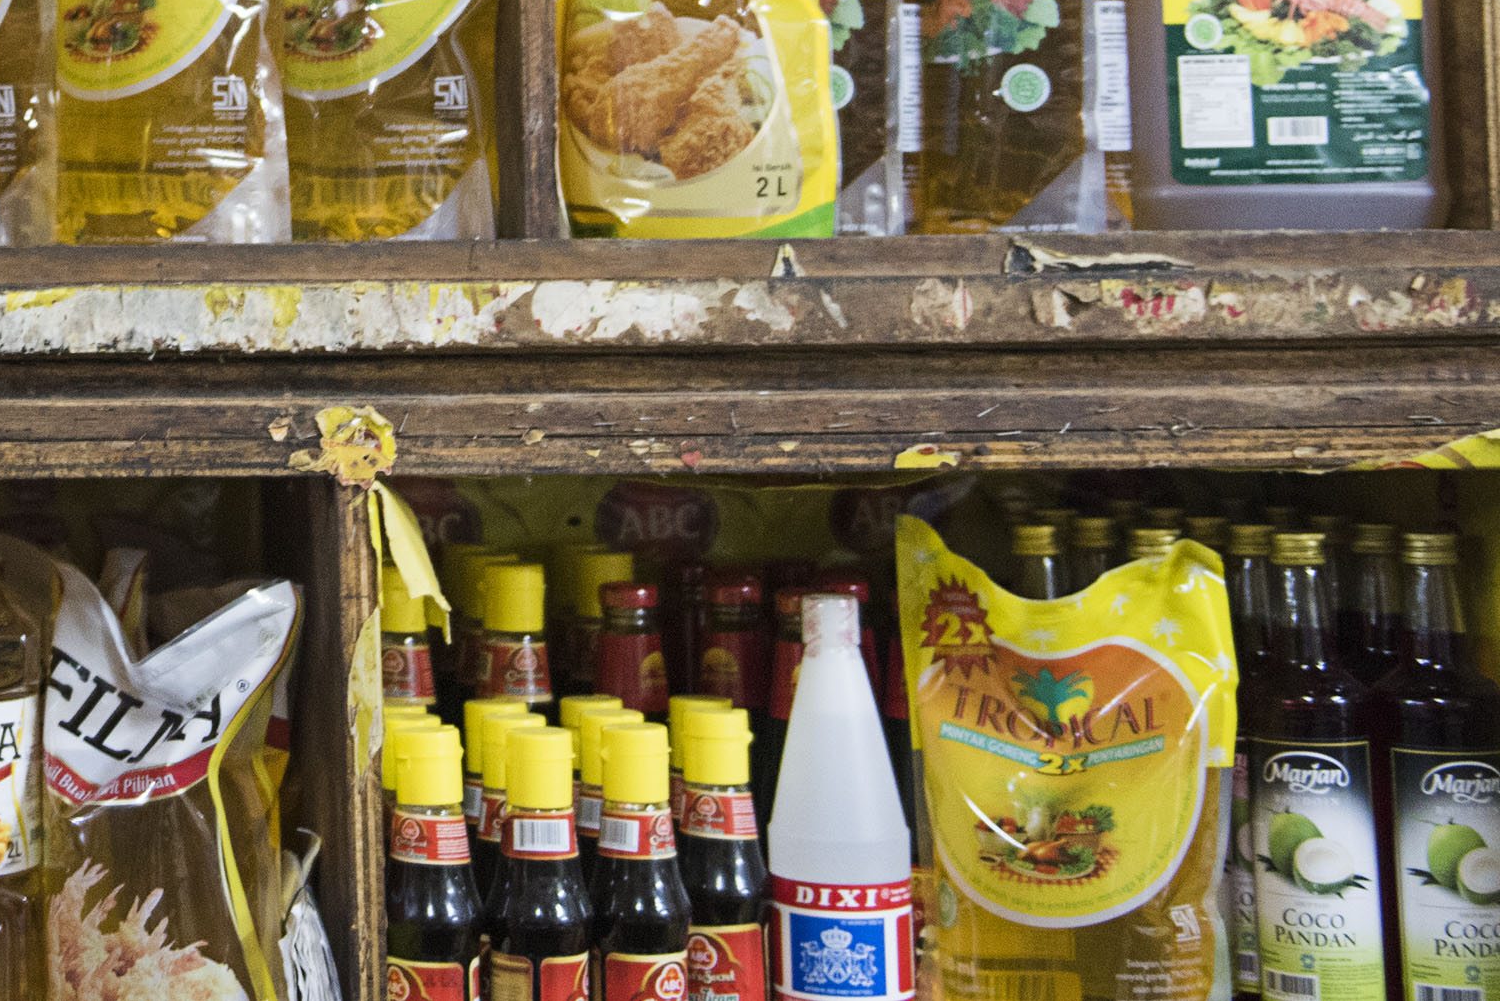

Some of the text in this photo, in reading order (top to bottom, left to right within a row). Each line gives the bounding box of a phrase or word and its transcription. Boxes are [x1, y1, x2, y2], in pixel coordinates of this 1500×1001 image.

[433, 74, 469, 110] SNI
[617, 503, 702, 542] ABC
[936, 612, 989, 645] 2x
[950, 683, 1165, 750] TROPICAL
[942, 725, 987, 748] MINYAK
[987, 739, 1038, 766] GORENG
[1035, 752, 1088, 776] 2x
[122, 773, 177, 794] Pilihan
[1264, 755, 1350, 794] Marjan
[7, 839, 23, 860] 2L
[795, 885, 879, 908] DIXI
[1281, 908, 1346, 929] COCO
[1444, 920, 1500, 940] COC
[1274, 923, 1357, 948] PANDAN
[662, 979, 685, 993] ABC
